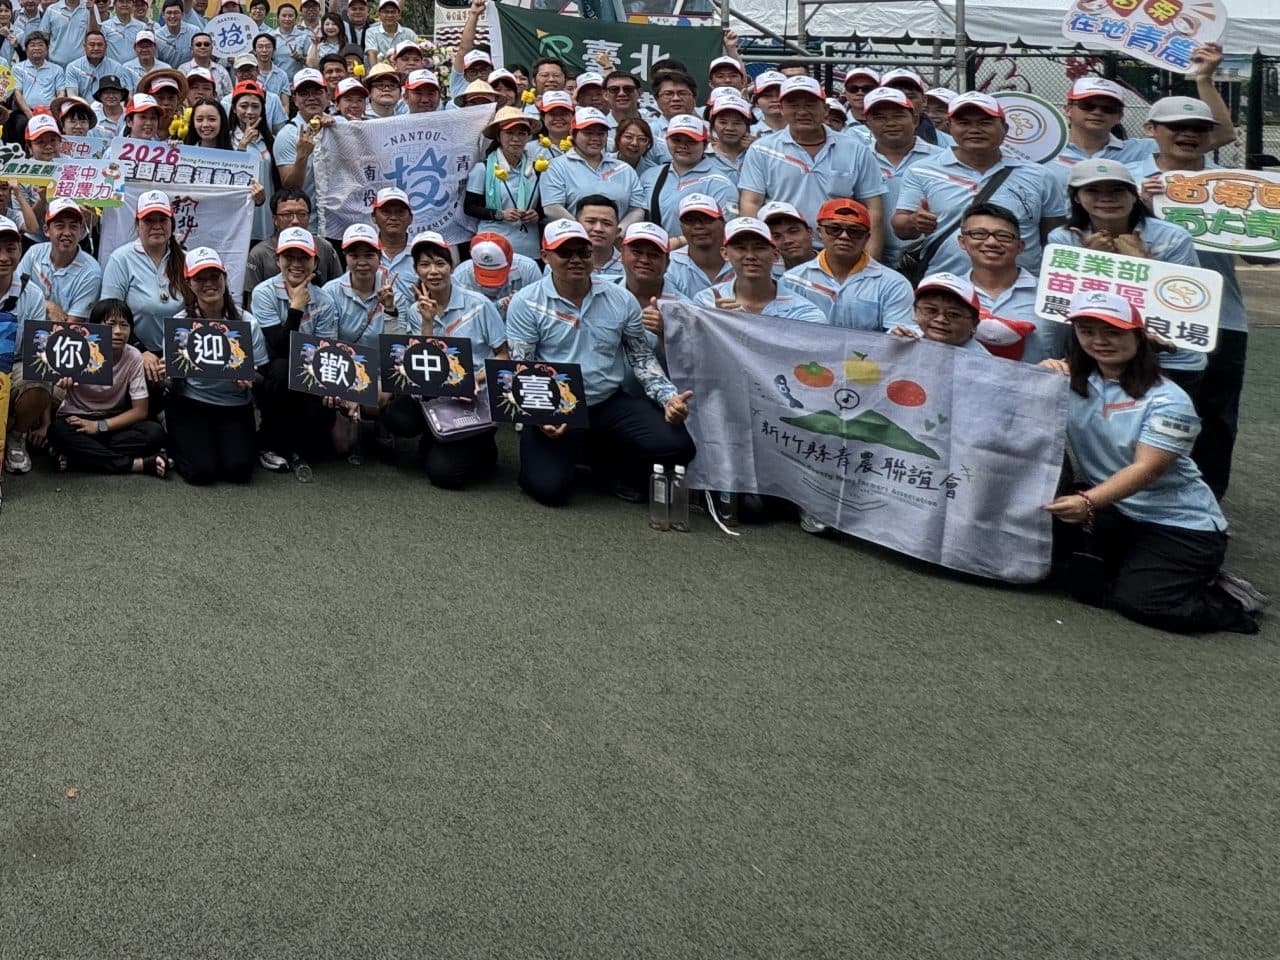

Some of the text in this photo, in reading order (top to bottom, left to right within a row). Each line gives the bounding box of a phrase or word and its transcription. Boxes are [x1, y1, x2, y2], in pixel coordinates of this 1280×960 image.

[1068, 11, 1198, 70] 在地青農
[119, 143, 180, 165] 2026
[390, 131, 441, 146] NANTOU
[54, 180, 113, 200] 超農力
[60, 165, 98, 181] 臺中
[1048, 248, 1151, 283] 農業部
[1041, 294, 1210, 348] 農良場
[53, 335, 84, 369] 你
[194, 333, 225, 365] 迎
[411, 349, 440, 381] 中
[320, 351, 350, 388] 歡
[517, 375, 555, 410] 臺
[761, 420, 962, 499] 新竹縣青農聯誼會
